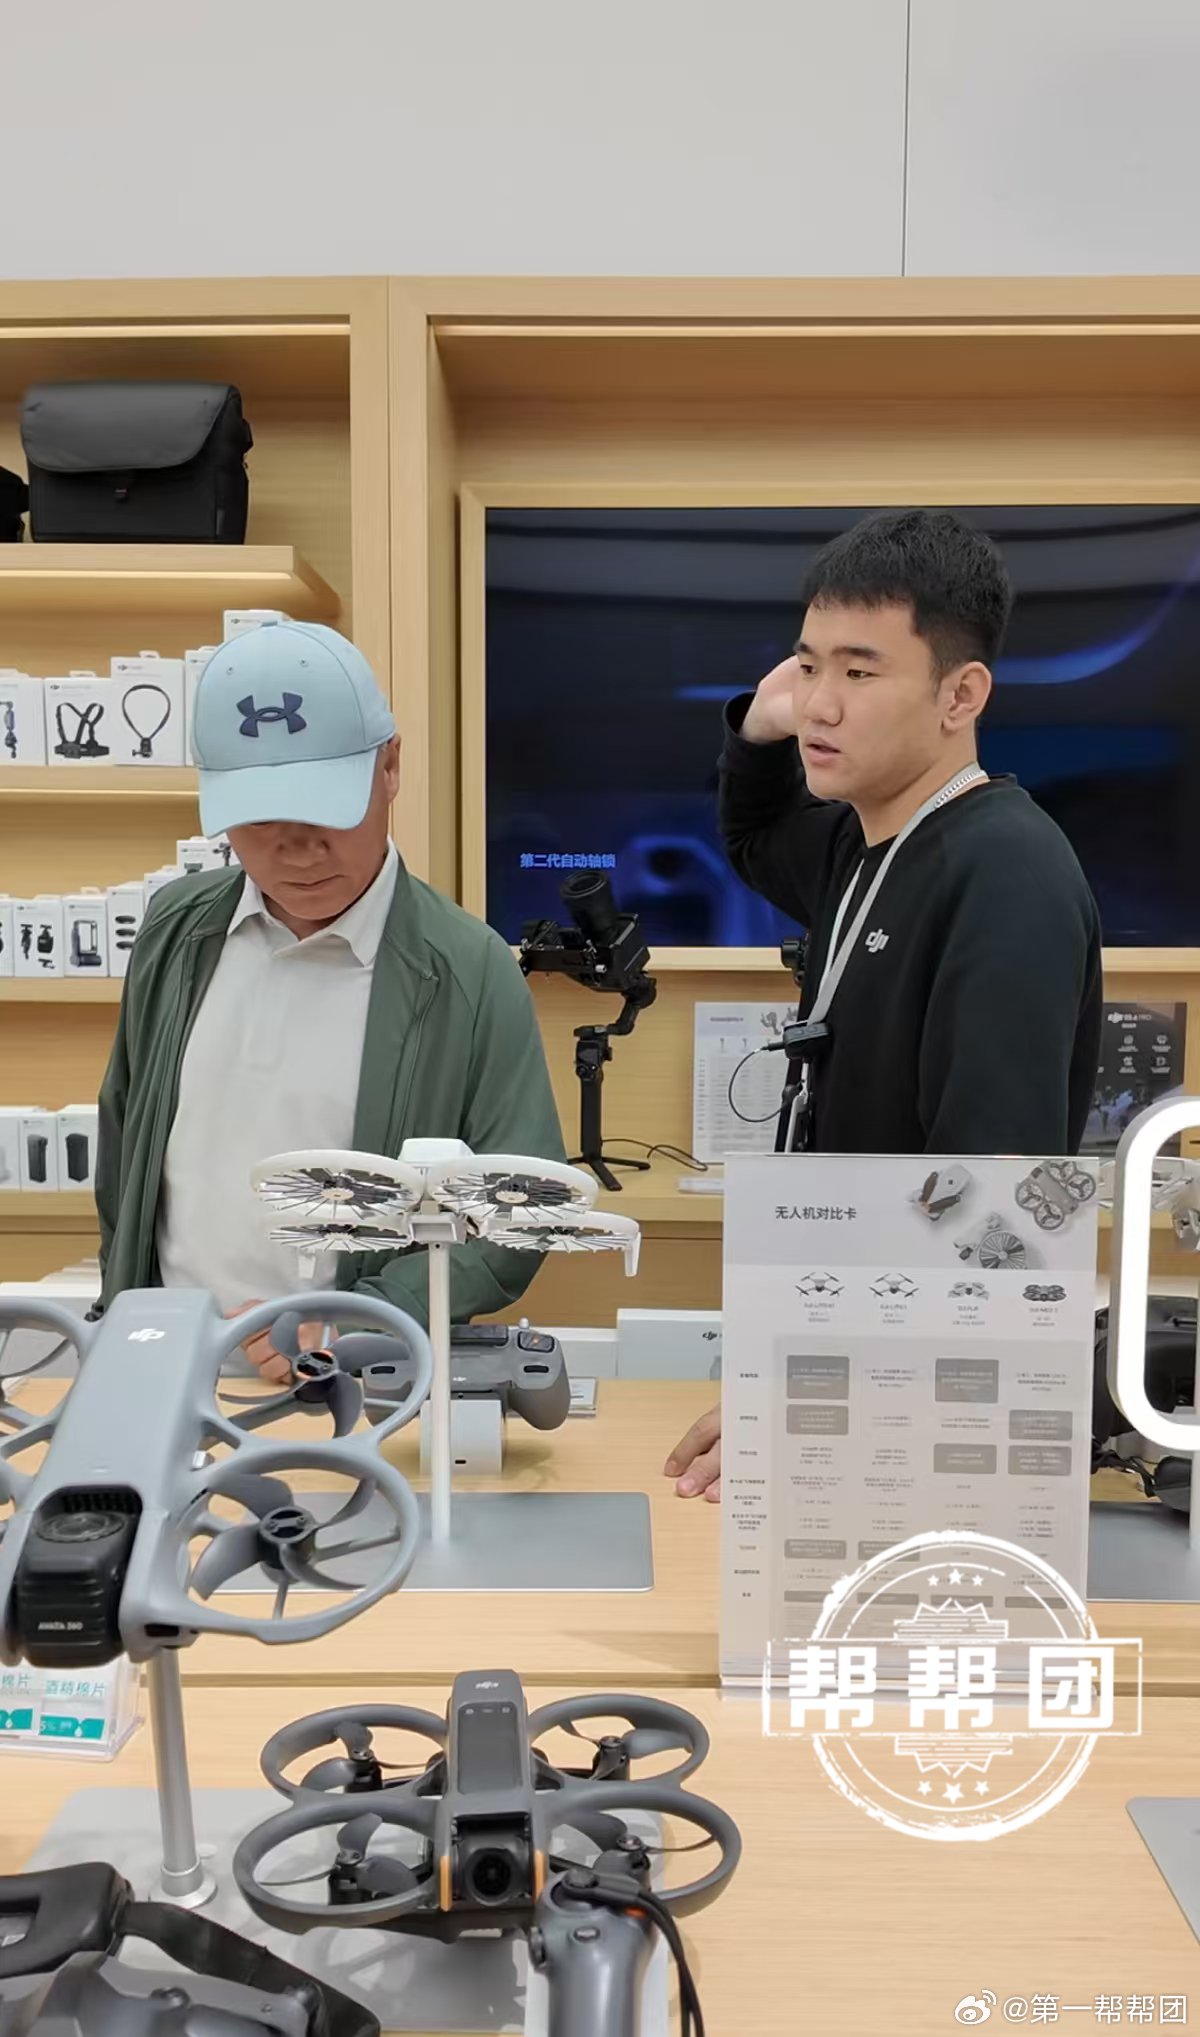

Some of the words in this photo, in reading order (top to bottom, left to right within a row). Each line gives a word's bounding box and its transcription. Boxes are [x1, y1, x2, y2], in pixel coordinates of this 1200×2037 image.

[519, 853, 617, 869] 第二代自动轴锁
[775, 1206, 857, 1221] 无人机对比卡
[38, 1621, 66, 1631] AVATA
[45, 1679, 105, 1697] 酒精棉片
